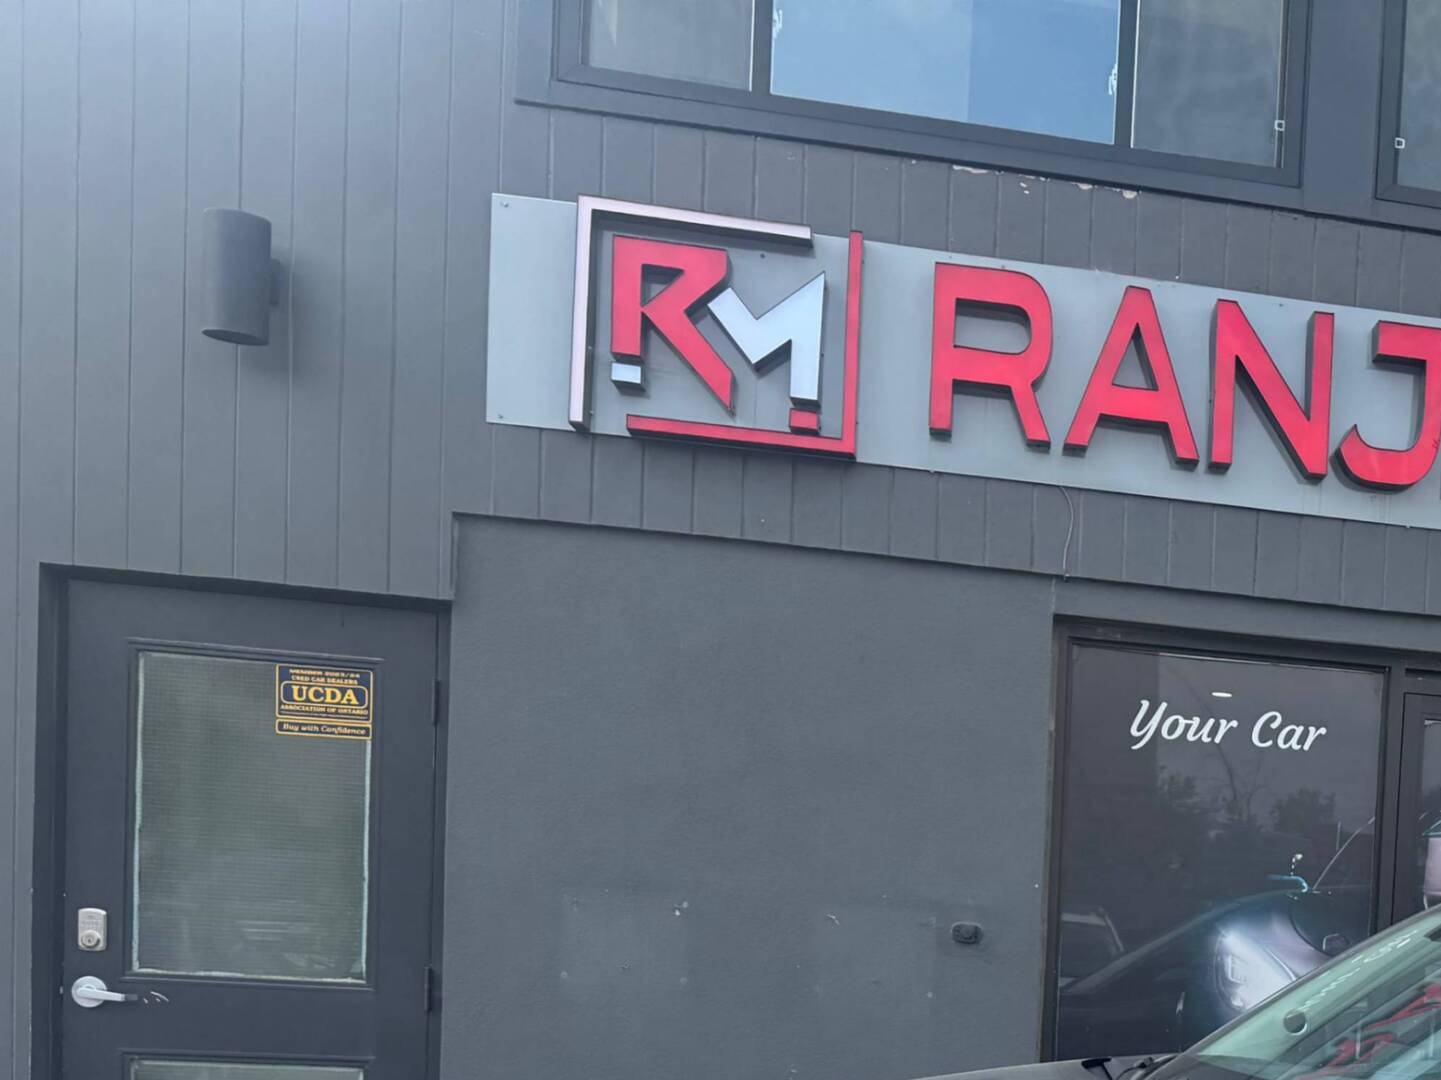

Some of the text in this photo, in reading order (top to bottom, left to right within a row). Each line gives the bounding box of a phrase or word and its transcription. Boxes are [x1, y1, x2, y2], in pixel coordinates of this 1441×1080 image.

[327, 677, 358, 686] DEALERS
[291, 685, 360, 705] UCDA
[280, 704, 327, 713] ASSOCIATION
[338, 707, 369, 716] ONTARIO
[282, 722, 367, 735] Buy with Confidence
[1130, 699, 1327, 751] Your Car
